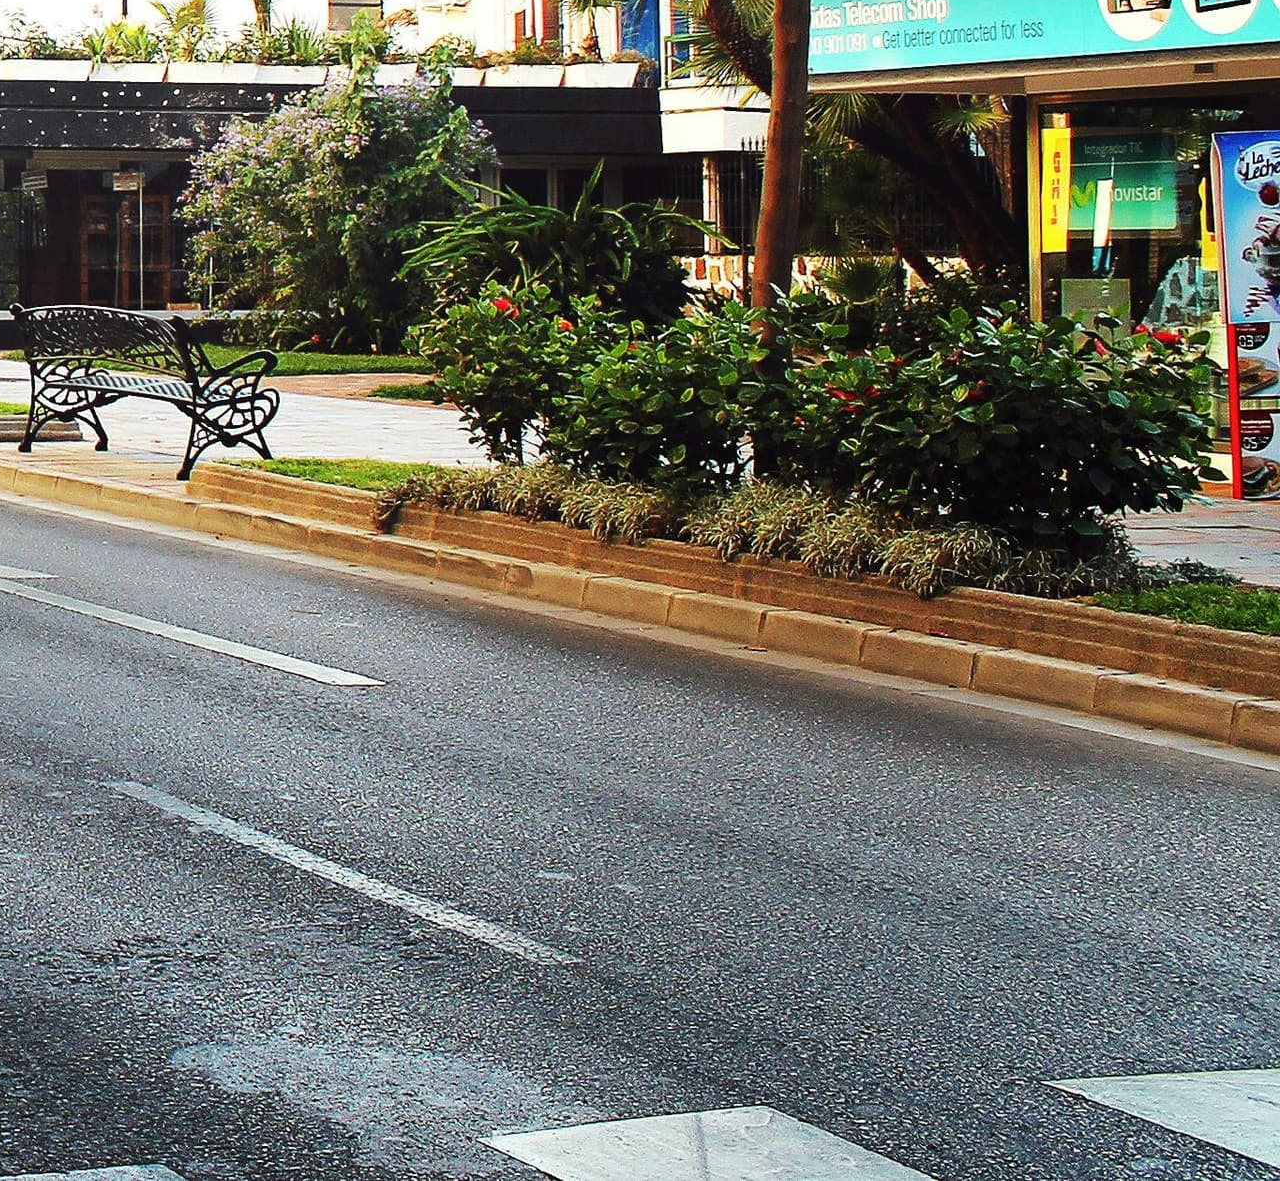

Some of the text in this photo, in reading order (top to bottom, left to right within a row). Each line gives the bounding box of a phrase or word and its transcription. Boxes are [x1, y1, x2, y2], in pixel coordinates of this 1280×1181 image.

[842, 0, 904, 28] Telecom
[882, 18, 1045, 49] Get better connected for less
[1252, 151, 1264, 165] La
